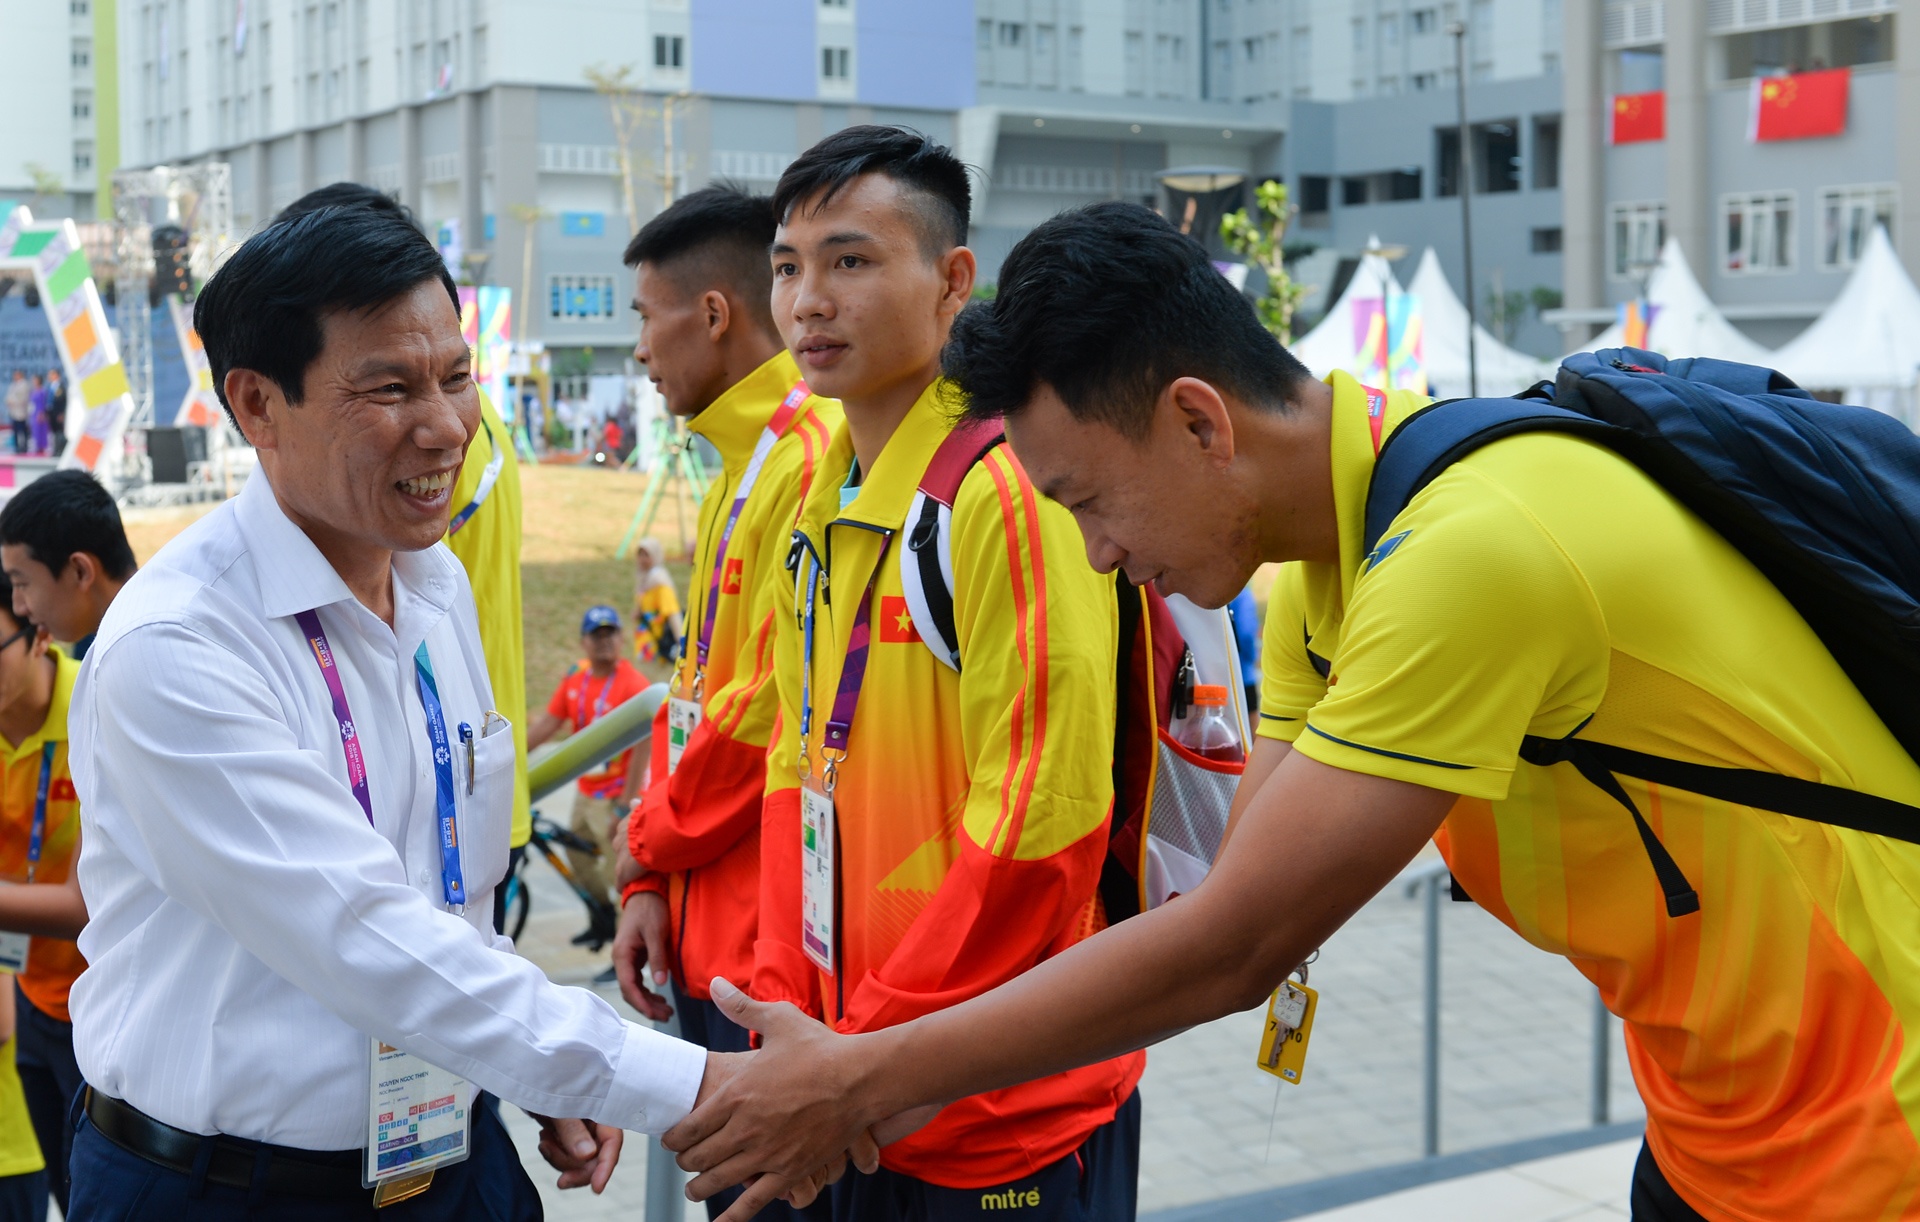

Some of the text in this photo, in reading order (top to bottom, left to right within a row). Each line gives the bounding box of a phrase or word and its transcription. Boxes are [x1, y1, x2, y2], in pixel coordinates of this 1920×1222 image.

[352, 743, 360, 763] ASIAN
[356, 763, 364, 788] GAMES
[379, 1078, 399, 1088] NGUYEN
[981, 1188, 1040, 1210] mitre
